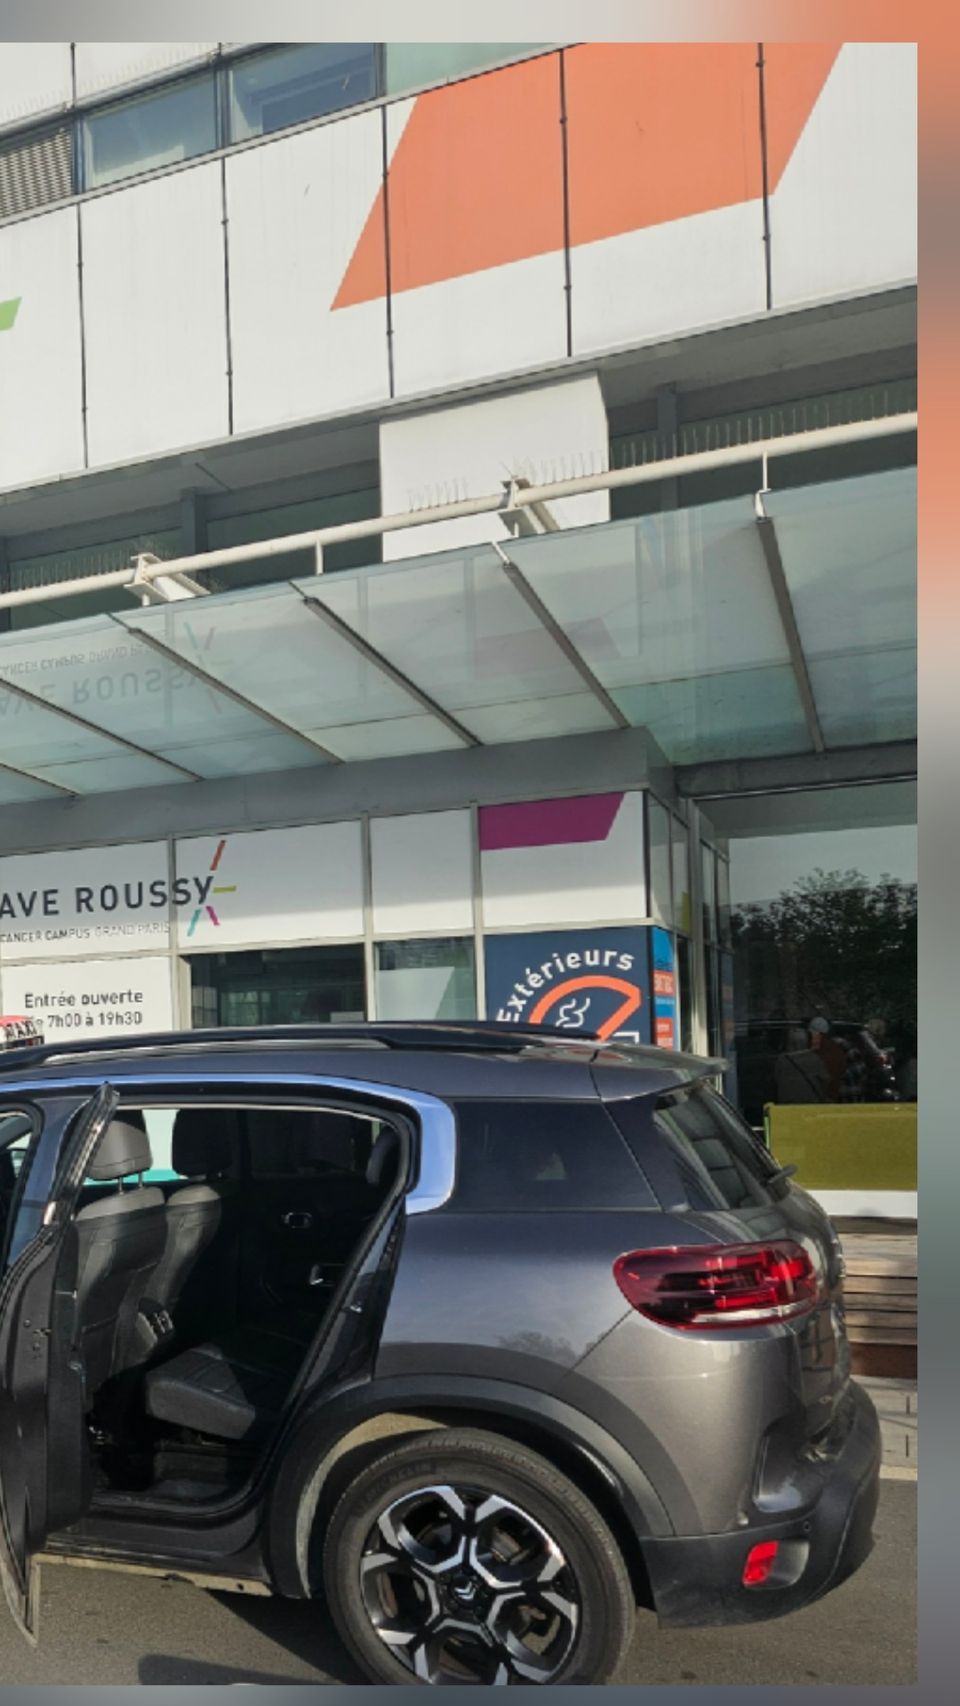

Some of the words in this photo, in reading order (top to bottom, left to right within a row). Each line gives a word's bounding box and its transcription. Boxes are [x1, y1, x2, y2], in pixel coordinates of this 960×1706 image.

[75, 875, 215, 914] ROUSSY
[0, 929, 43, 944] CANCER
[45, 926, 90, 941] CAMPUS
[95, 923, 135, 938] GRAND
[138, 920, 170, 935] PARIS
[495, 949, 636, 1022] Extérieurs
[24, 990, 76, 1009] Entrée
[81, 989, 143, 1006] ouverte
[47, 1014, 82, 1029] 7h00
[85, 1012, 94, 1026] à
[100, 1011, 143, 1027] 19h30
